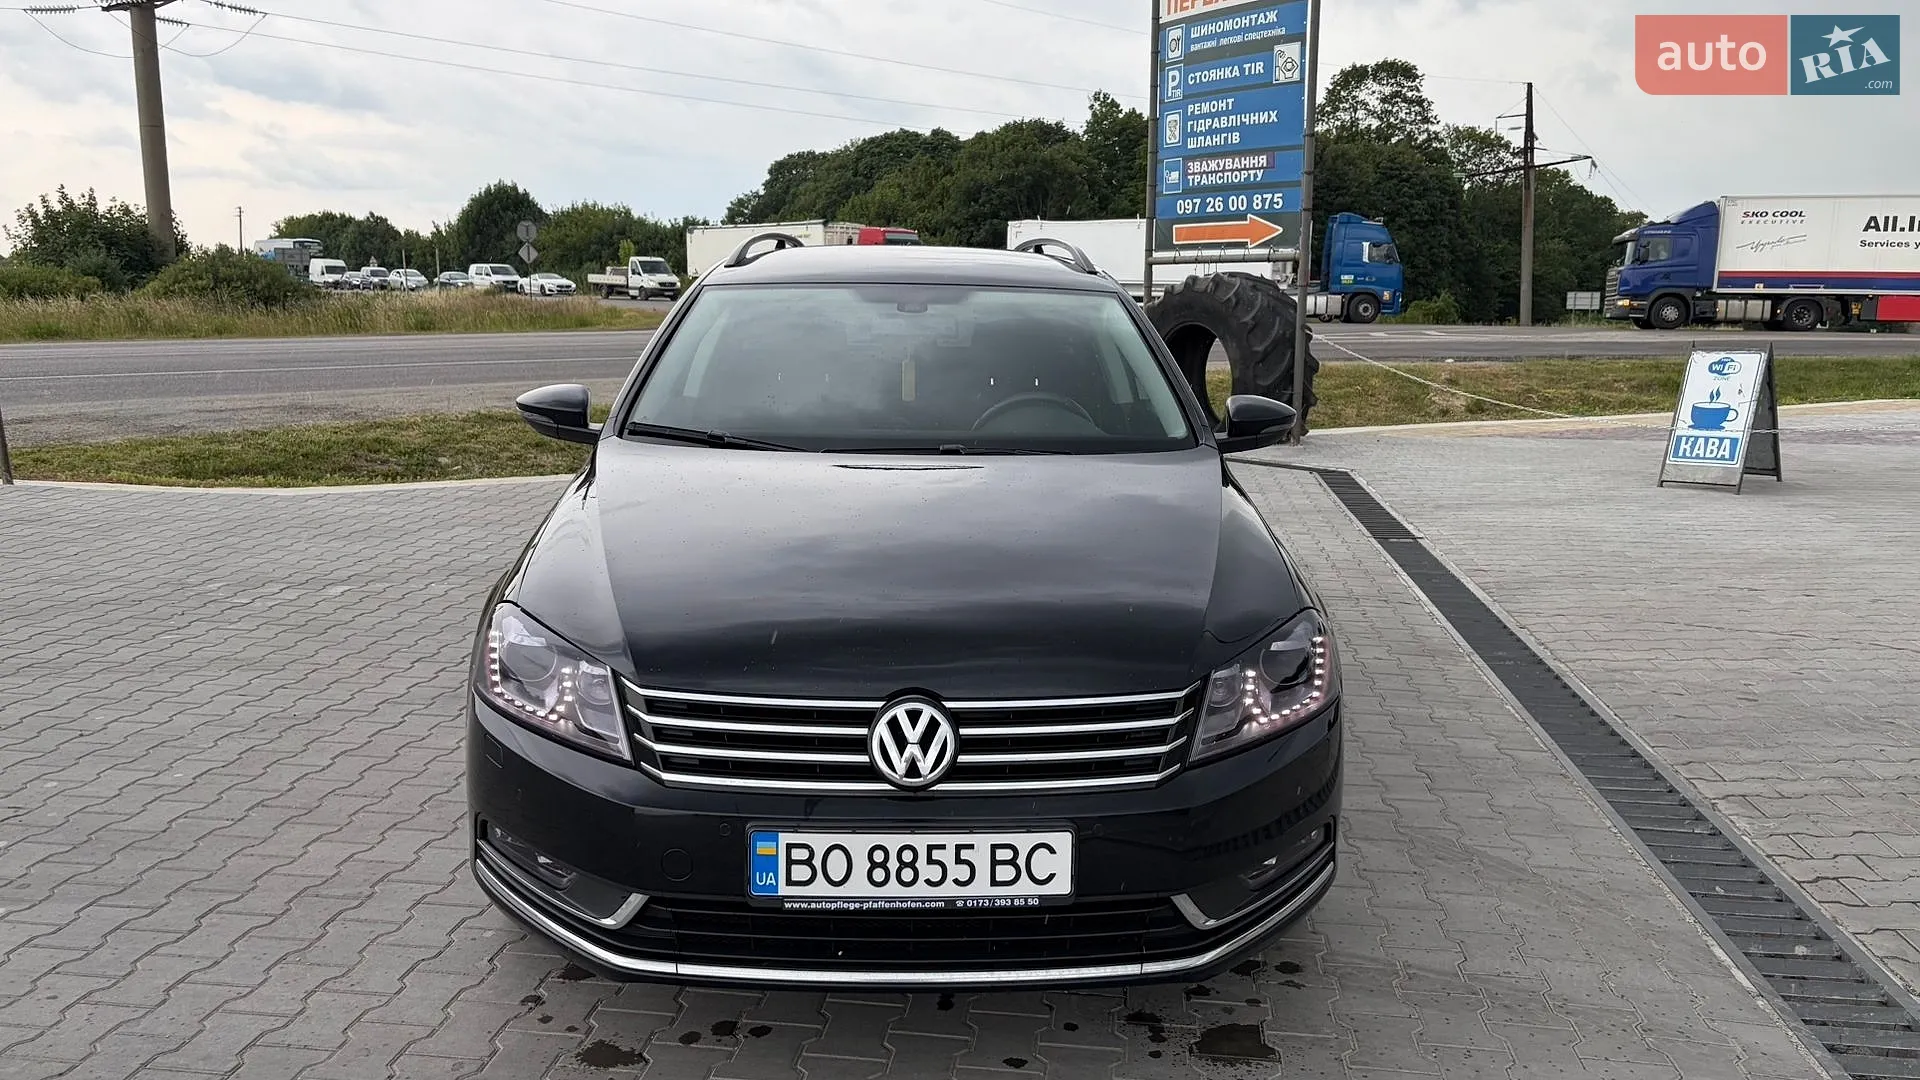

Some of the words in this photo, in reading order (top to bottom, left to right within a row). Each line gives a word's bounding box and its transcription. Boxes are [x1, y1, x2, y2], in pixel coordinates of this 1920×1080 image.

[1190, 10, 1279, 39] ШИНОМОНТАЖ
[1190, 37, 1217, 52] вантажні
[1219, 32, 1244, 46] легкові
[1244, 26, 1286, 41] спецтехніка
[1188, 65, 1240, 85] СТОЯНКА
[1243, 61, 1264, 76] TIR
[1167, 70, 1180, 97] P
[1171, 88, 1182, 98] TIR
[1187, 98, 1234, 116] РЕМОНТ
[1187, 110, 1278, 133] ГІДРАВЛІЧНИХ
[1187, 131, 1240, 149] ШЛАНГІВ
[1187, 155, 1267, 173] ЗВАЖУВАННЯ
[1187, 169, 1264, 187] ТРАНСПОРТУ
[1176, 198, 1201, 215] 097
[1206, 196, 1224, 213] 26
[1228, 195, 1247, 211] 00
[1253, 193, 1284, 210] 875
[1741, 210, 1769, 218] SKO
[1772, 210, 1806, 218] COOL
[1862, 215, 1920, 232] All.I
[1859, 239, 1910, 248] Services
[1677, 436, 1731, 459] КАВА
[784, 842, 854, 887] BO
[867, 843, 977, 888] 8855
[989, 842, 1058, 887] BC
[755, 872, 777, 886] UA
[784, 900, 945, 910] www.autopflege-pfaffenhofen.com
[1013, 898, 1026, 906] 85
[1027, 897, 1040, 906] 50
